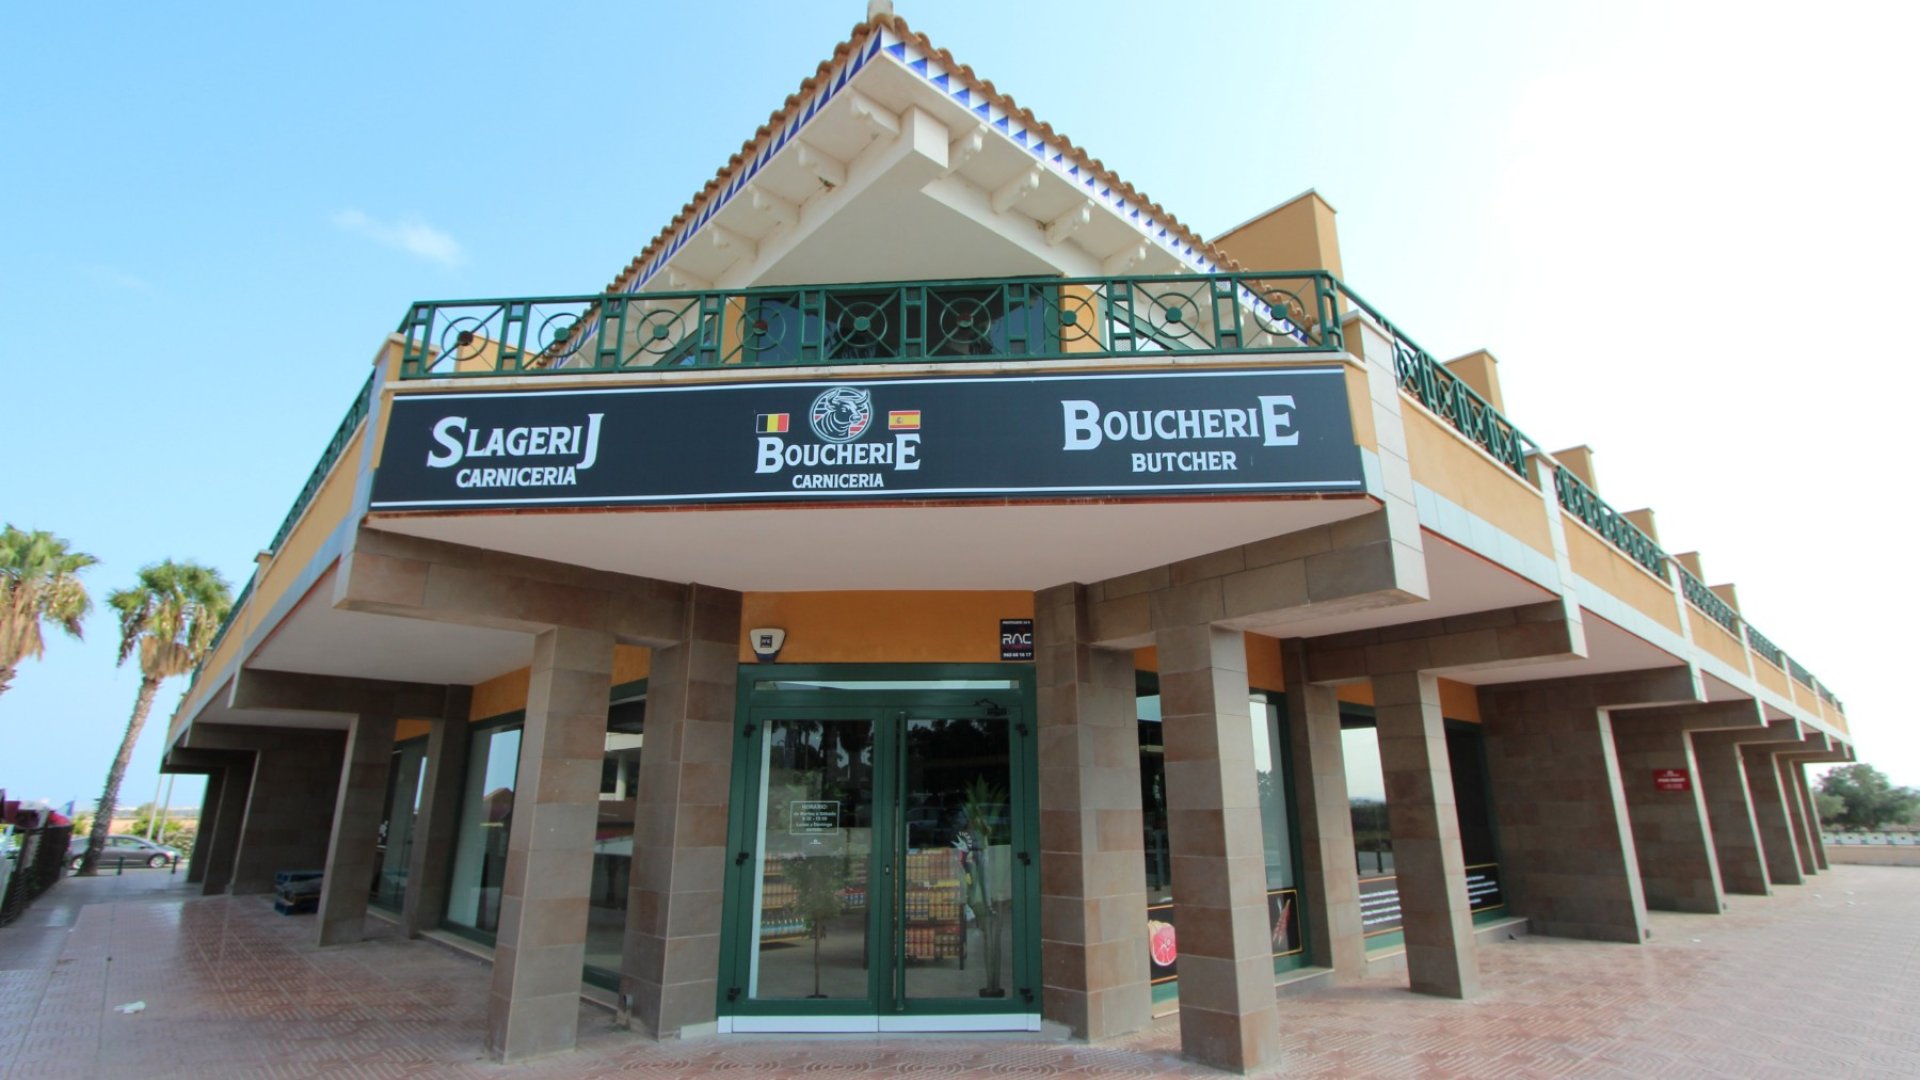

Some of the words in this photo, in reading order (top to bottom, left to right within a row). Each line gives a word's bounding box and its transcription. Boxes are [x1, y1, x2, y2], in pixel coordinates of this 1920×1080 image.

[1060, 395, 1300, 451] BOUCHERIE
[426, 412, 605, 469] SLAGERIJ
[754, 433, 922, 474] BOUCHERIE
[1131, 451, 1238, 473] BUTCHER
[455, 465, 578, 489] CARNICERIA
[792, 473, 885, 489] CARNICERIA
[1002, 633, 1032, 645] RAC
